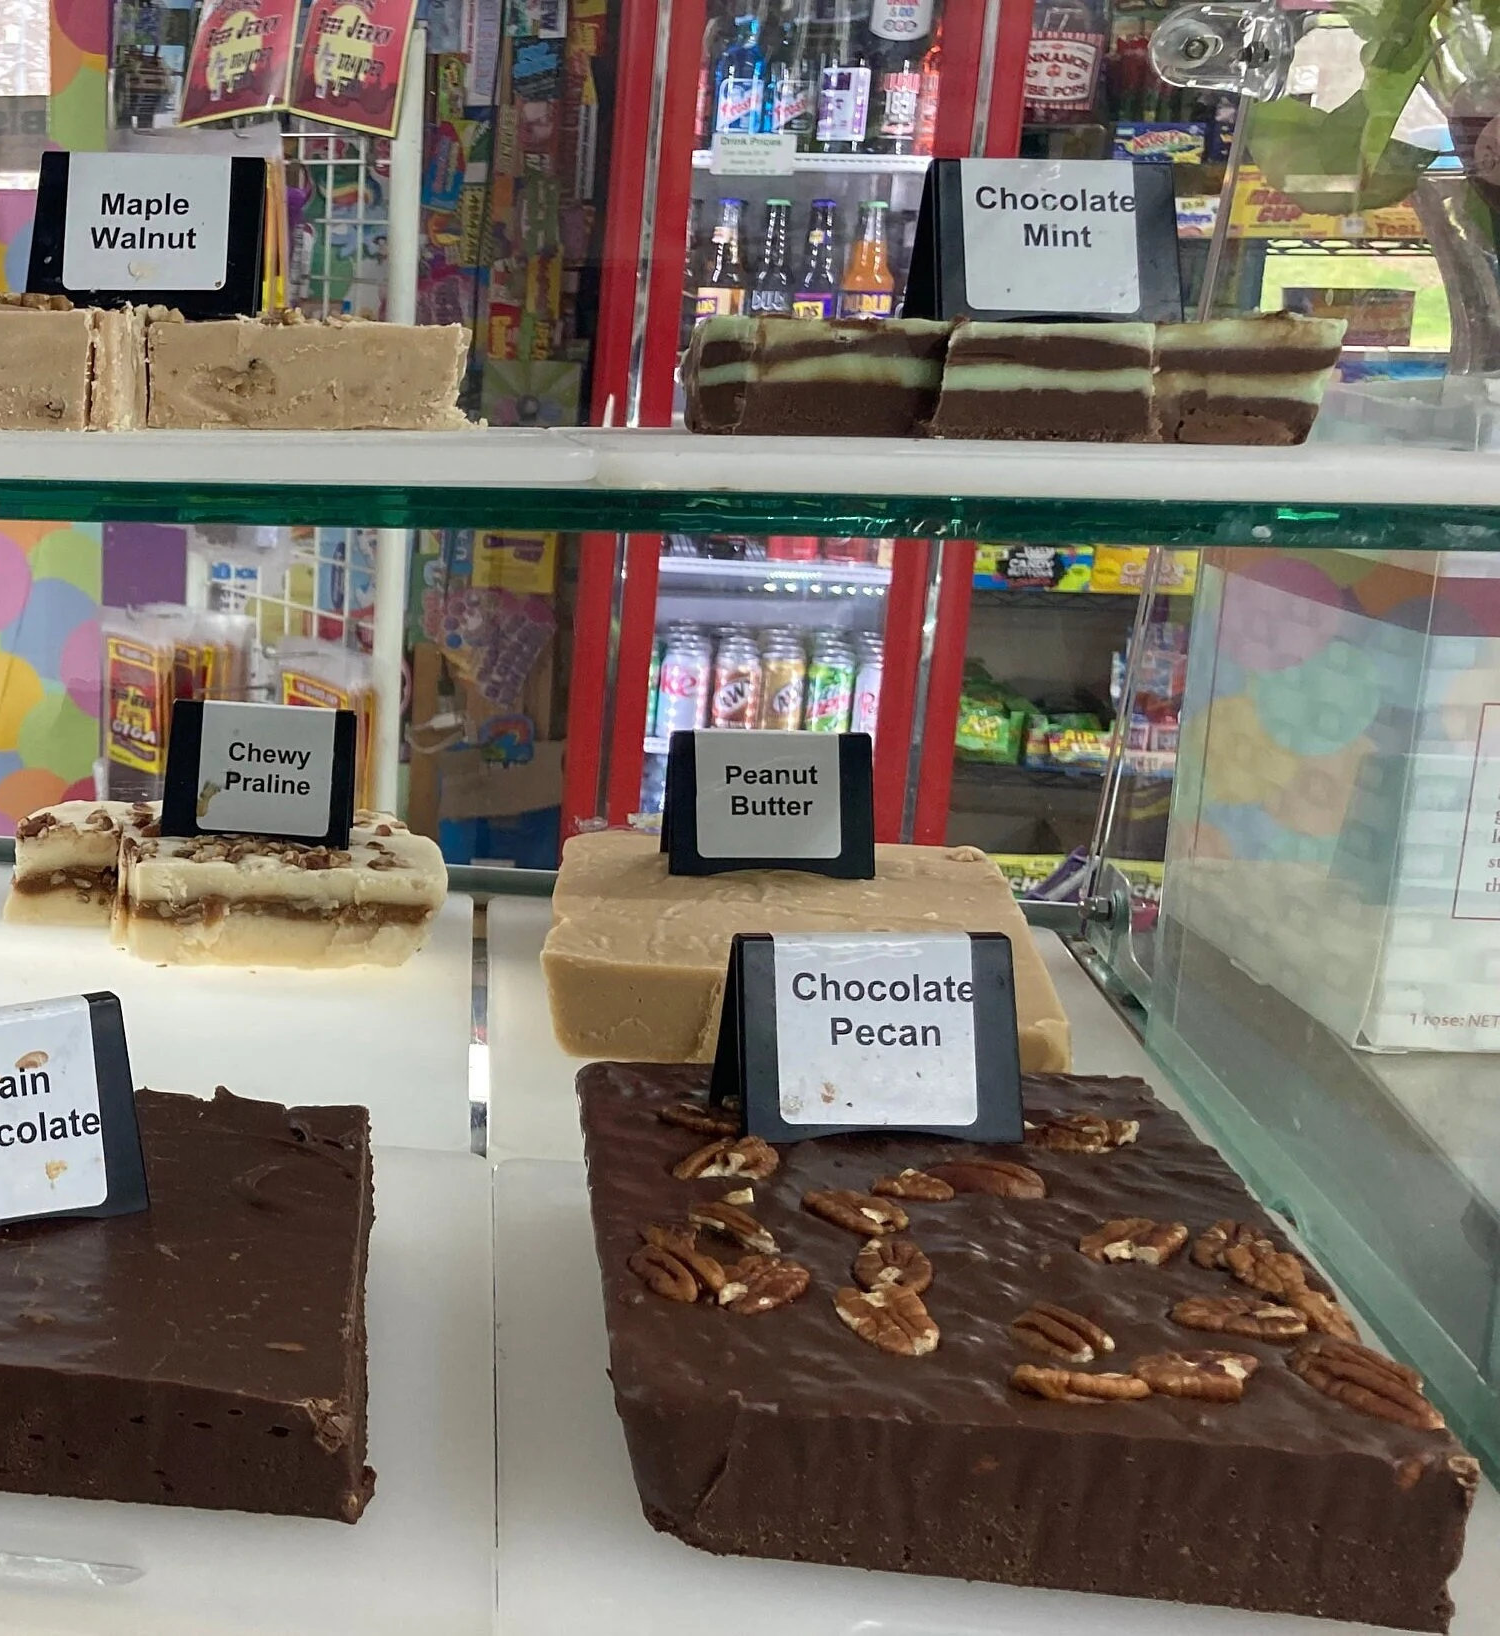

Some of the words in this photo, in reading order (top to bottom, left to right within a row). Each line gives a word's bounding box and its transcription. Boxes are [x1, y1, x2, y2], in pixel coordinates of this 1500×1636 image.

[100, 192, 190, 221] Maple
[975, 185, 1136, 213] Chocolate
[90, 226, 197, 250] Walnut
[1023, 222, 1092, 248] Mint
[228, 741, 311, 771] Chewy
[224, 771, 311, 796] Praline
[725, 764, 818, 785] Peanut
[731, 795, 813, 816] Butter
[791, 971, 974, 1003] Chocolate
[830, 1017, 941, 1047] Pecan
